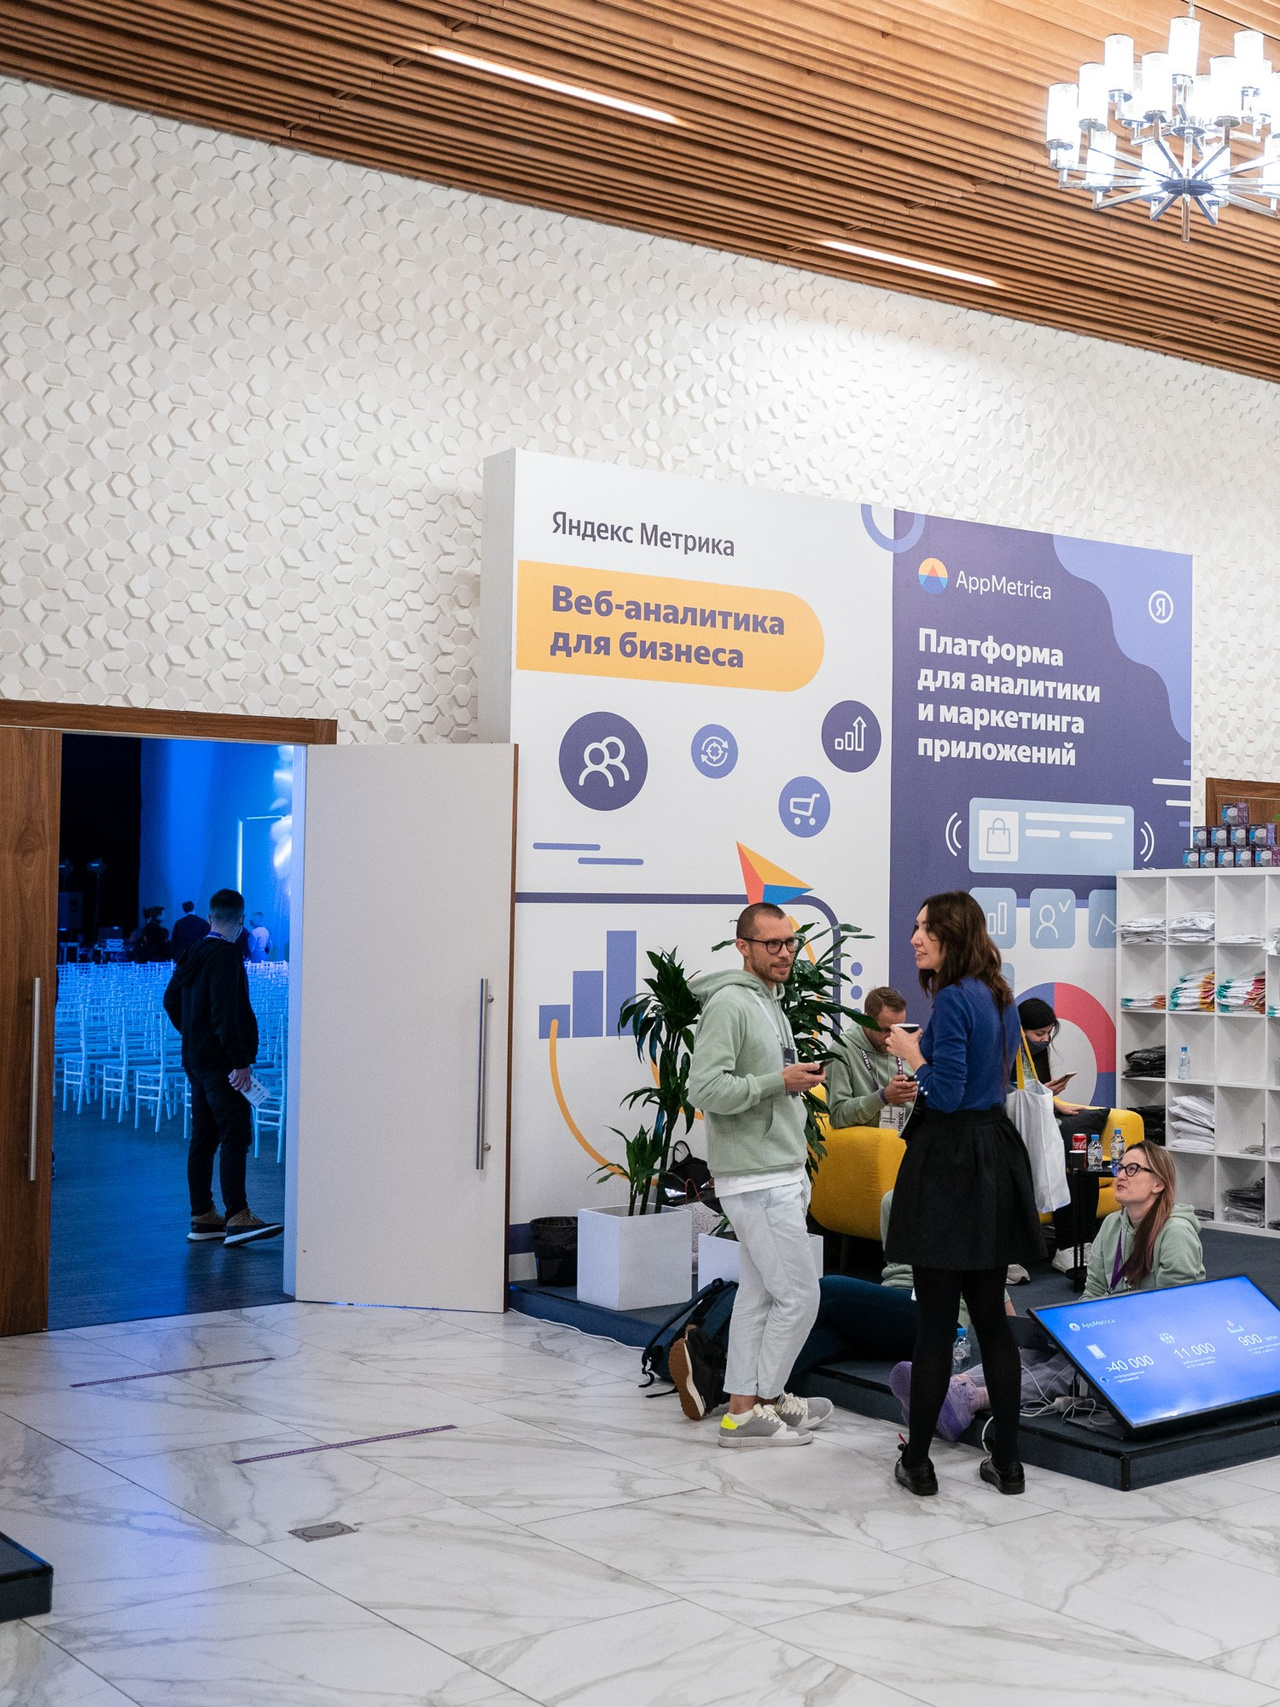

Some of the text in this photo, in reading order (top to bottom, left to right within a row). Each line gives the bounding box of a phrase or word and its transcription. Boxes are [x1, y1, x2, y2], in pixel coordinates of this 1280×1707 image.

[551, 511, 735, 557] Яндекс Метрика
[955, 570, 1052, 600] AppMetrica
[551, 585, 785, 636] Веб-аналитика
[549, 630, 744, 668] для бизнеса
[918, 627, 1064, 668] Платформа
[917, 668, 1101, 704] для аналитики
[918, 703, 1085, 734] и маркетинга
[917, 737, 1076, 767] приложений
[1174, 1342, 1216, 1359] 11 000
[1237, 1333, 1263, 1346] 900
[1127, 1354, 1154, 1368] 000
